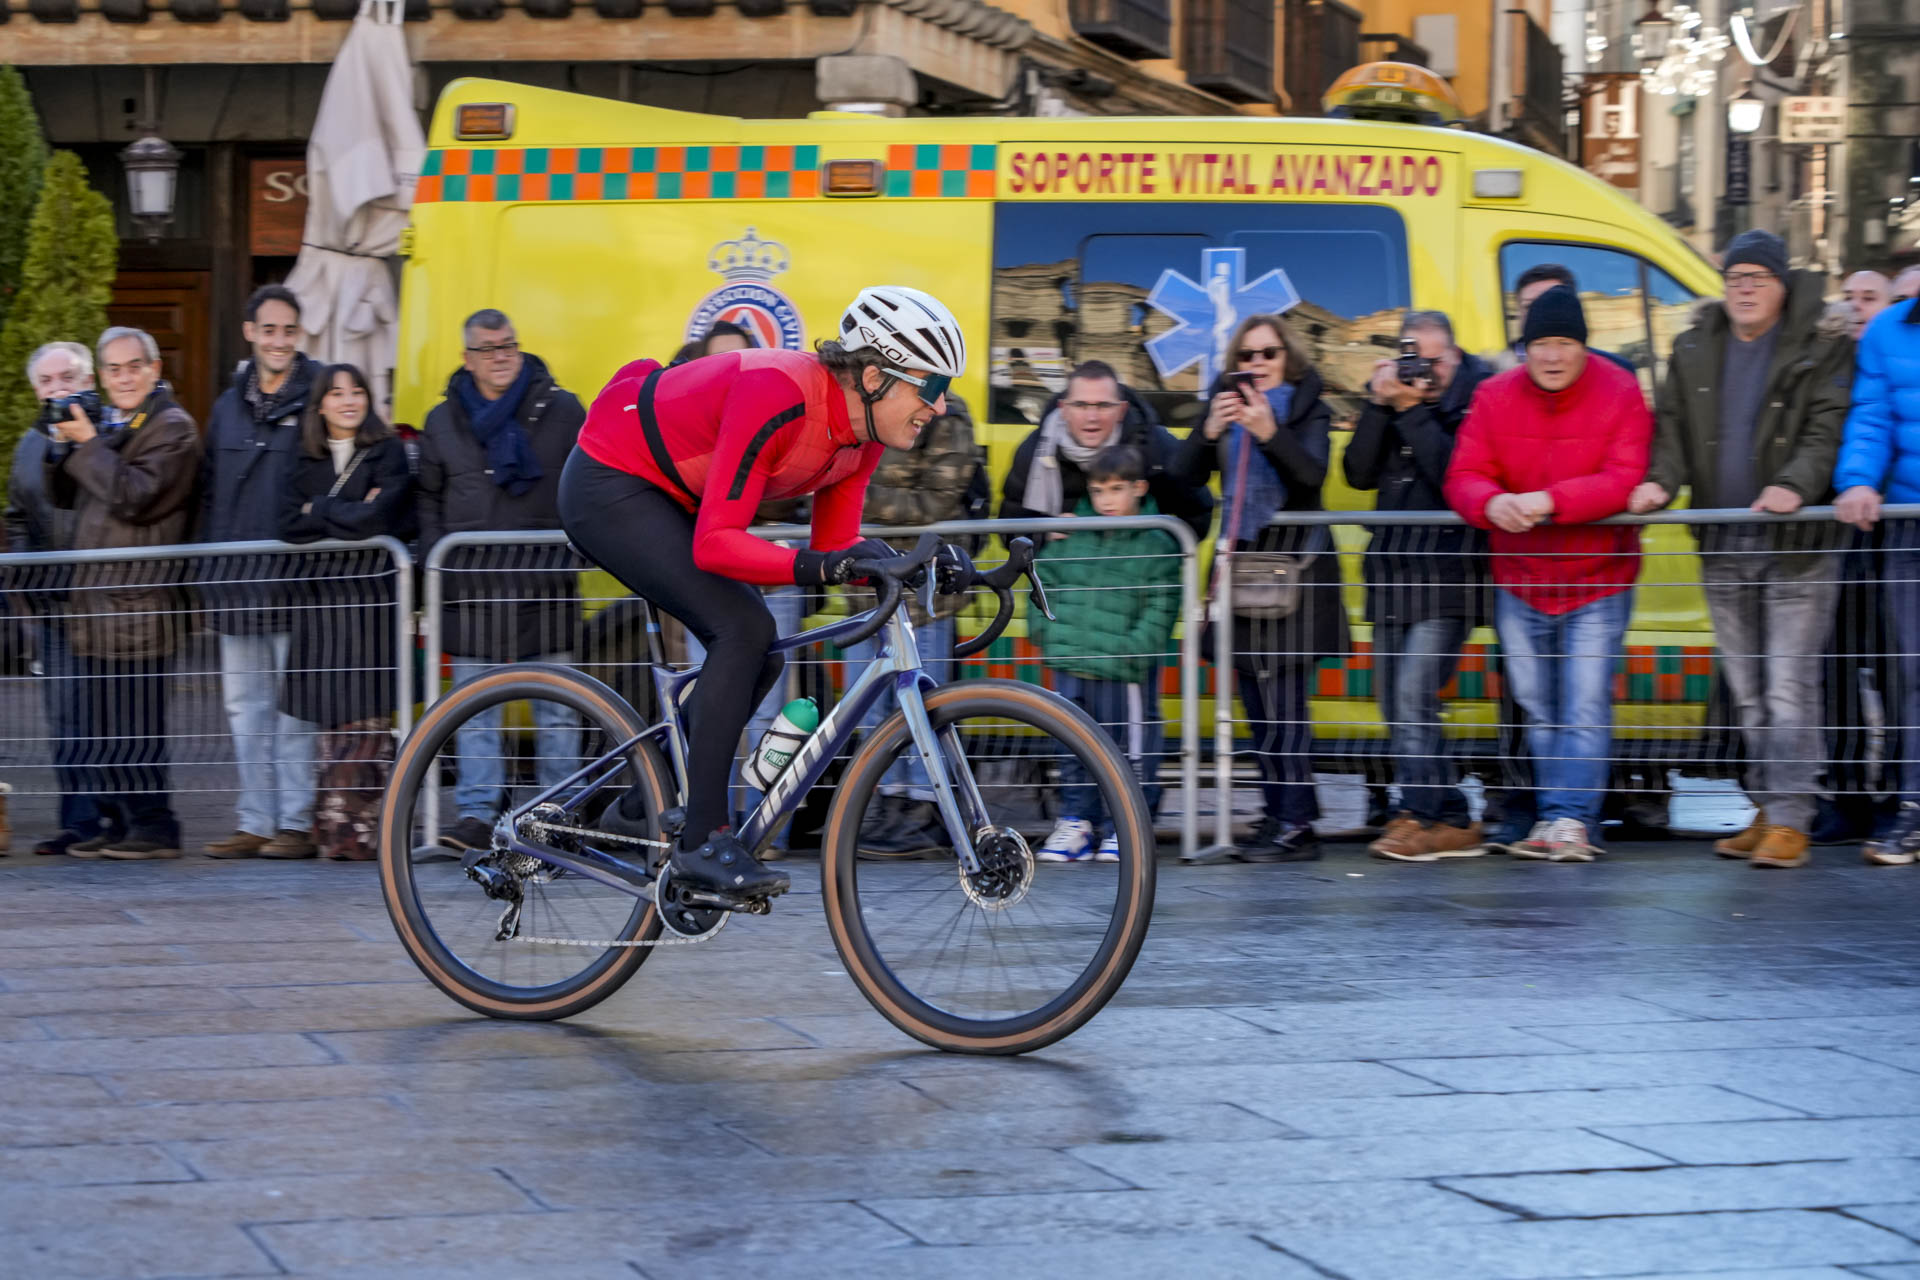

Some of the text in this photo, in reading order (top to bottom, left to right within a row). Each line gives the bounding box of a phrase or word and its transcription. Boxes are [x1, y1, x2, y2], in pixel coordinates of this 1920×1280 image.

[1010, 151, 1443, 197] SOPORTE VITAL AVANZADO
